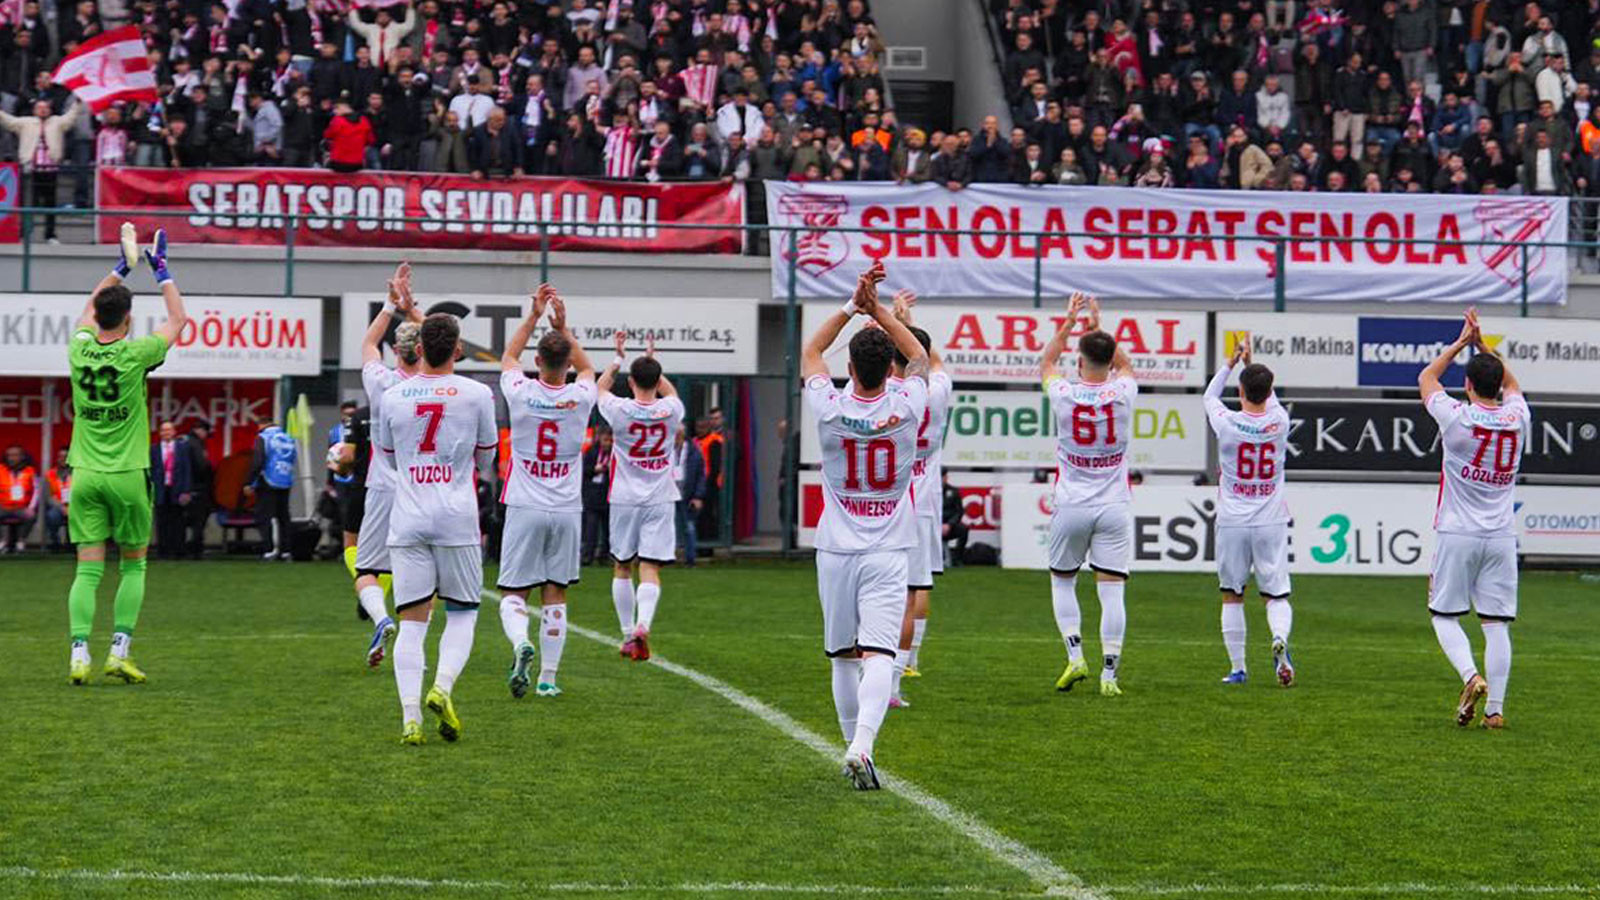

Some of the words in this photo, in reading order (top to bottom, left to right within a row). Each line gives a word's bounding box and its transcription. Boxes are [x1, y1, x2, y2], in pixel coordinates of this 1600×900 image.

[187, 182, 406, 232] SEBATSPOR
[420, 189, 658, 238] SEVDALILARI
[970, 205, 1073, 260] OLA
[1083, 207, 1246, 261] SEBAT
[1255, 209, 1353, 278] ŞEN
[1363, 212, 1467, 264] OLA
[176, 310, 307, 348] DÖKÜM
[1253, 335, 1285, 357] Koç
[1291, 335, 1355, 356] Makina
[1361, 342, 1471, 365] KOMATU
[1507, 340, 1539, 363] Koç
[1546, 342, 1600, 362] Makin
[79, 365, 120, 401] 43
[415, 402, 445, 454] 7
[537, 420, 559, 462] 6
[628, 421, 666, 457] 22
[1072, 401, 1117, 446] 61
[842, 438, 897, 490] 10
[1237, 441, 1277, 480] 66
[1469, 425, 1518, 473] 70
[409, 465, 452, 484] TUZCU
[523, 460, 569, 478] TALHA
[1232, 483, 1257, 498] ONUR
